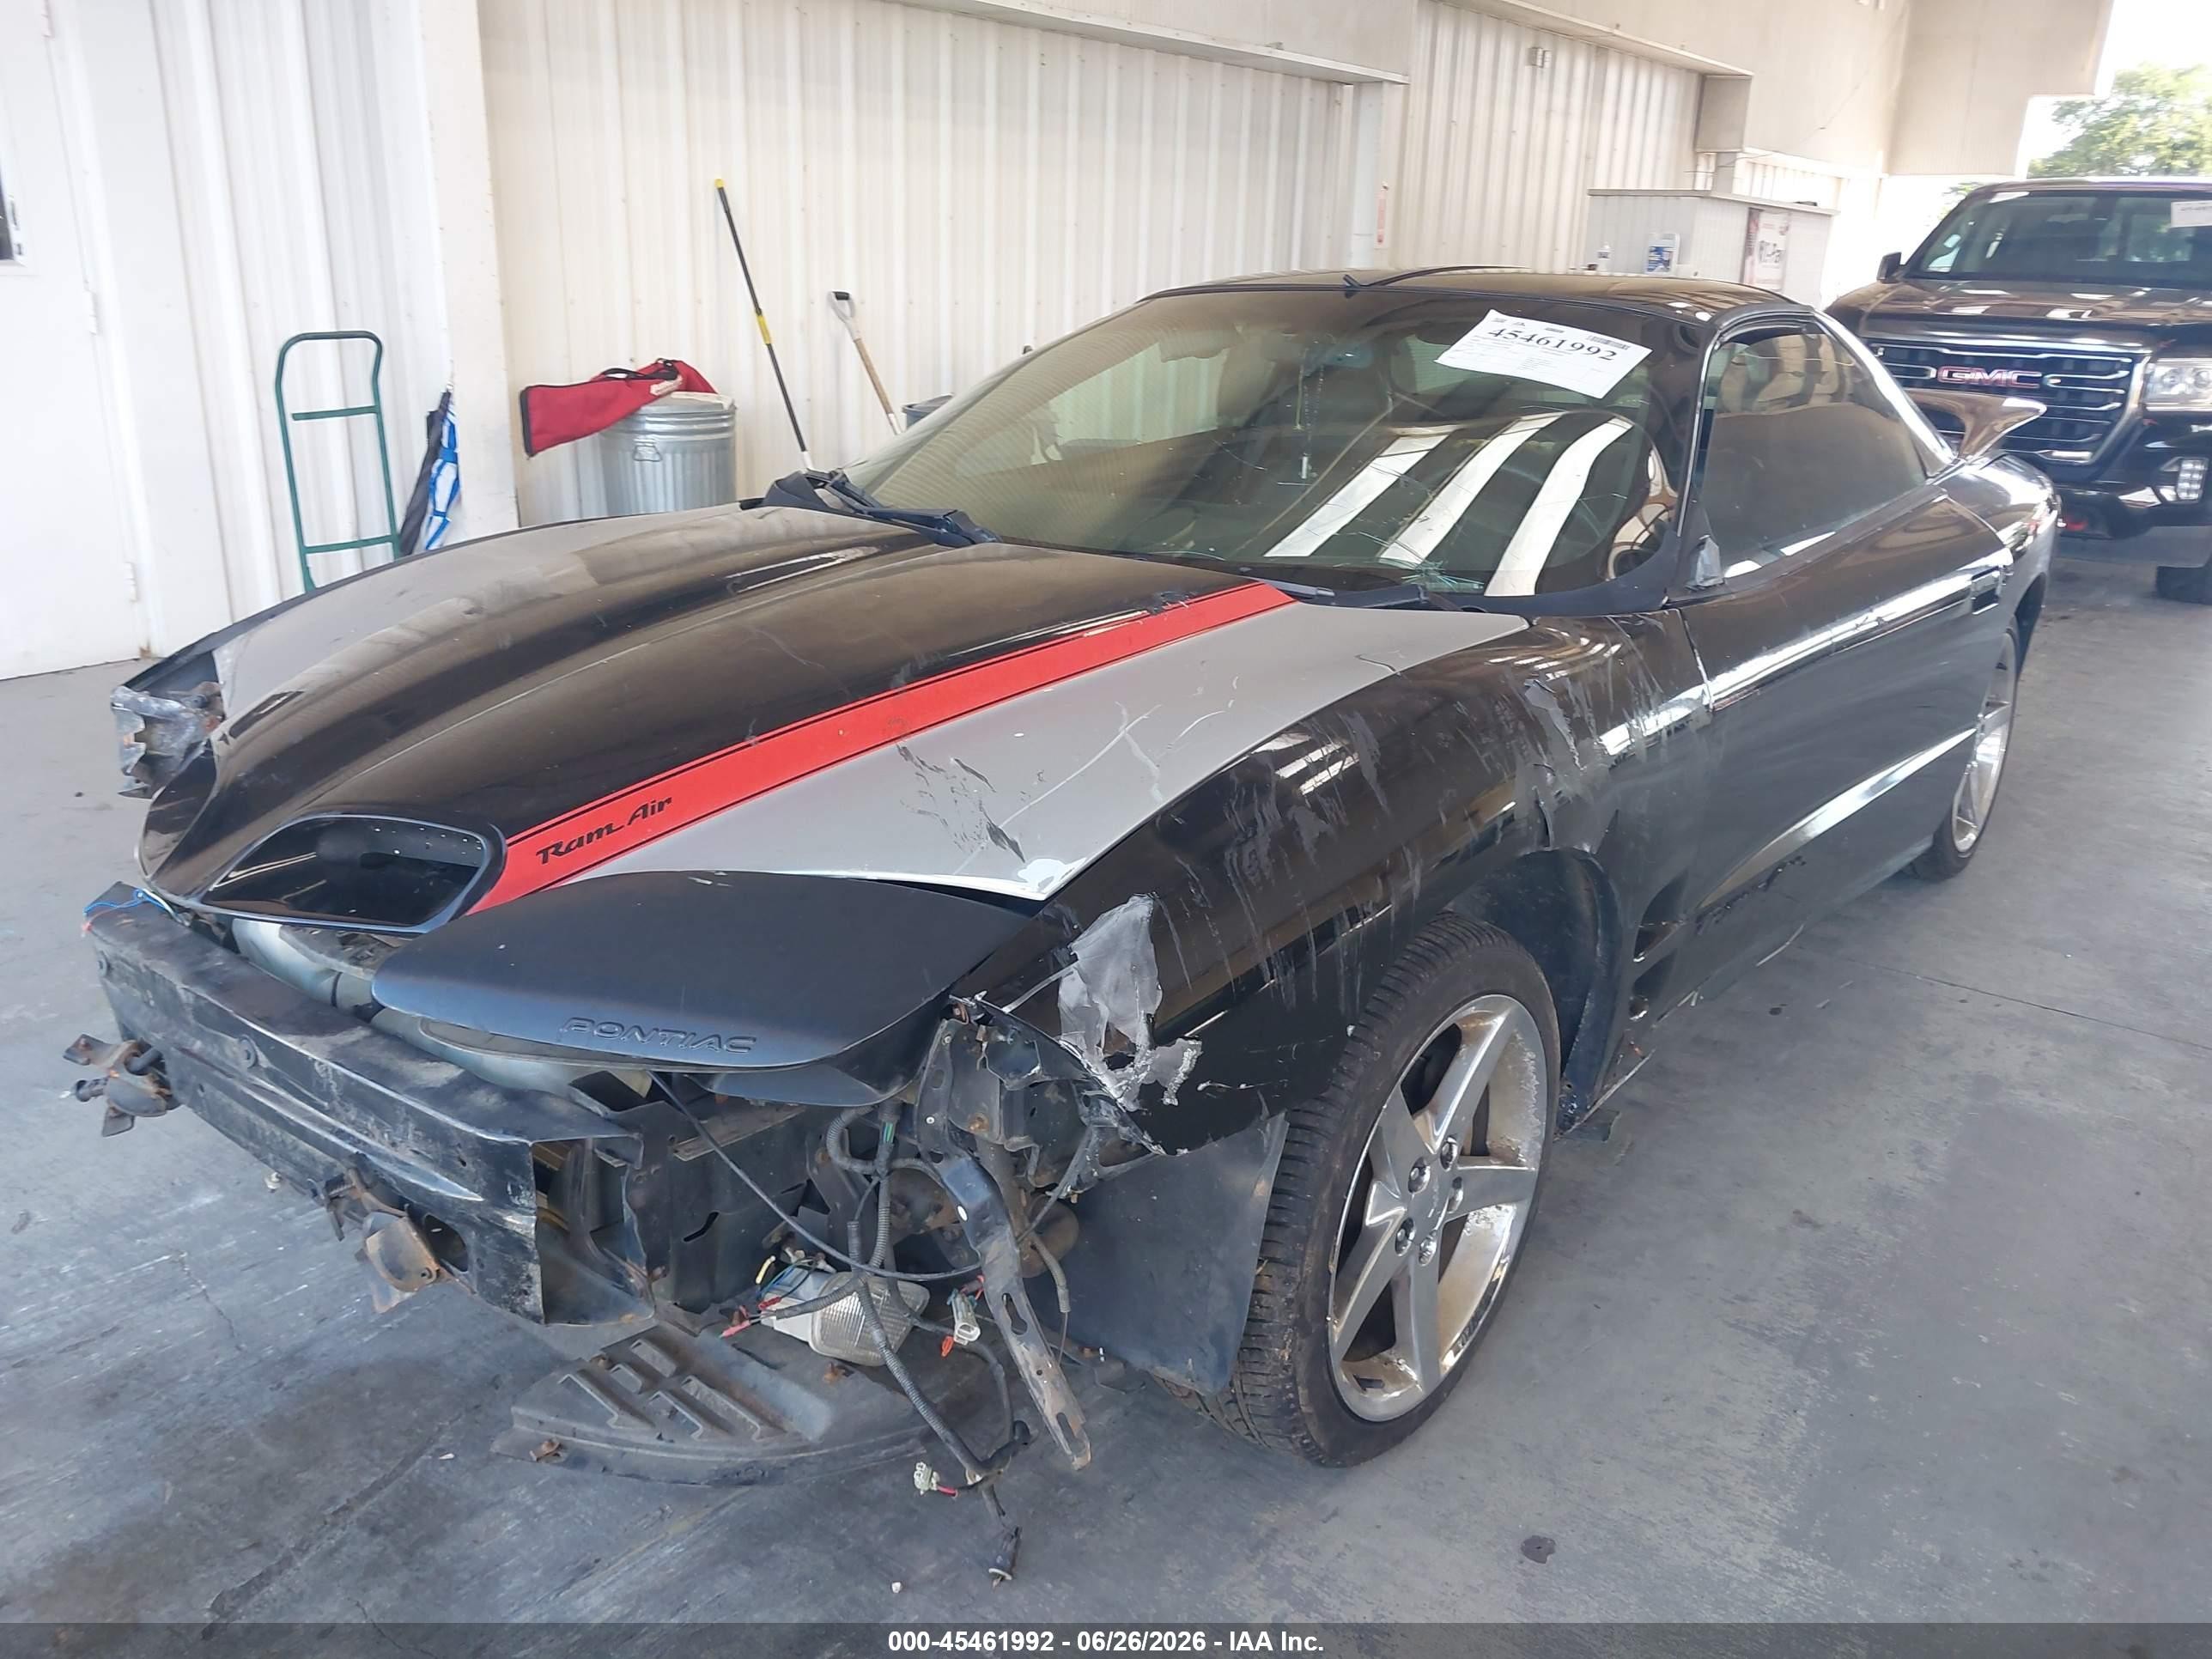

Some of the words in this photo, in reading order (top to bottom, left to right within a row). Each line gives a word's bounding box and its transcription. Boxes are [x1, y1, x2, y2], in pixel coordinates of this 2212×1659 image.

[1487, 328, 1619, 362] 45461992
[1937, 365, 2043, 390] GMC
[536, 823, 625, 865] Ram
[628, 797, 672, 825] Air
[559, 1017, 757, 1054] PONTIAC
